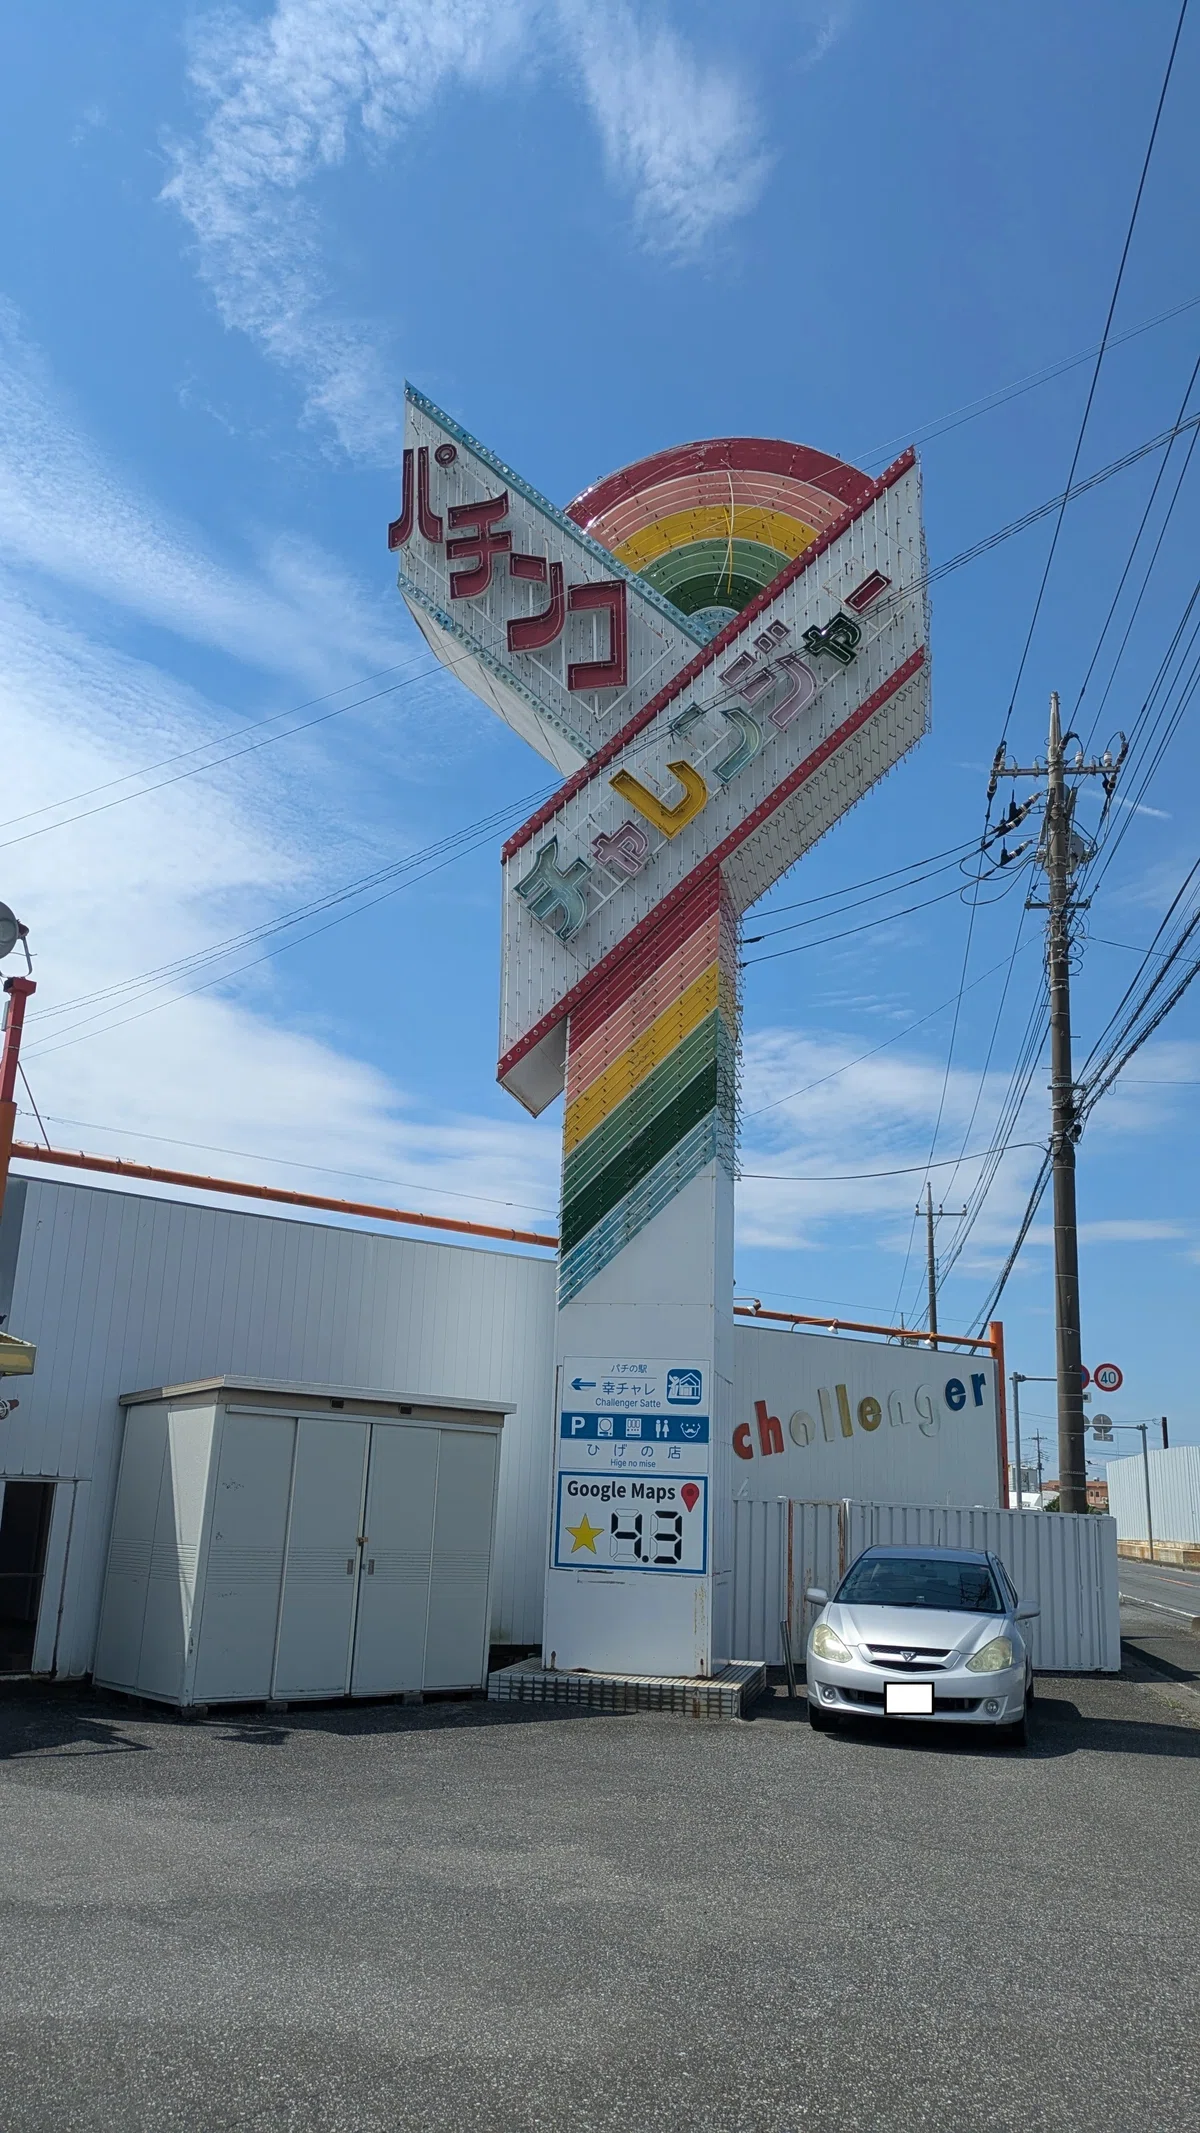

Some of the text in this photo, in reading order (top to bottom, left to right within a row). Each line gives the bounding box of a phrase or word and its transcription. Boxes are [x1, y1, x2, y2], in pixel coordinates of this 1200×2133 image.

[388, 444, 627, 692] パチンコ
[512, 568, 892, 943] チャレンジャー
[610, 1363, 648, 1374] パチの駅
[1100, 1371, 1117, 1384] 40
[602, 1381, 656, 1396] 幸チャレ
[595, 1397, 661, 1409] Challenger Satte
[571, 1416, 586, 1435] P
[732, 1373, 986, 1460] challenger
[610, 1458, 627, 1468] Hige
[639, 1459, 656, 1468] mise
[567, 1480, 676, 1503] Google Maps
[610, 1509, 683, 1564] 4.3
